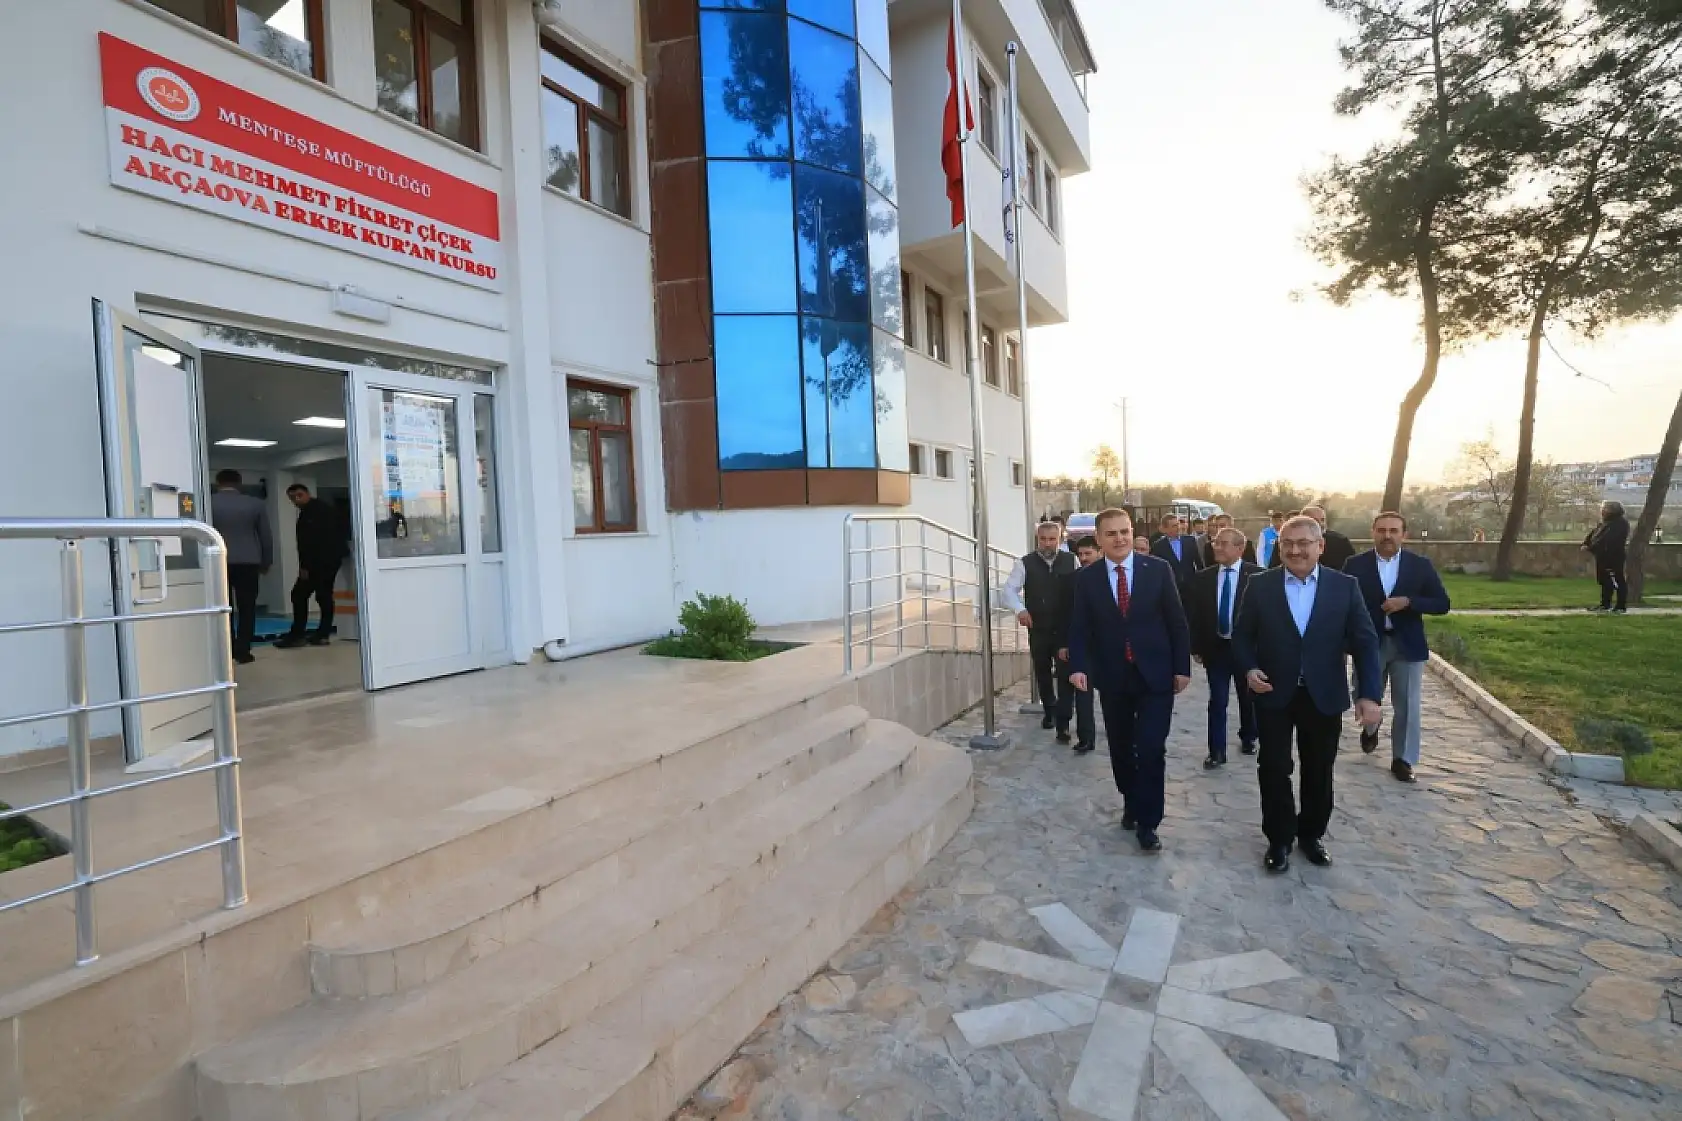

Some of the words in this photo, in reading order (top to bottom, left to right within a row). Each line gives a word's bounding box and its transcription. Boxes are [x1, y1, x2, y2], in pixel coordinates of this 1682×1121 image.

[121, 123, 205, 168] HACI
[210, 154, 331, 208] MEHMET
[335, 195, 414, 234] FİKRET
[417, 223, 474, 254] ÇİÇEK
[218, 106, 321, 157] MENTEŞE
[324, 147, 432, 198] MÜFTÜLÜĞÜ
[124, 154, 270, 214] AKÇAOVA
[273, 200, 359, 240] ERKEK
[361, 226, 436, 262] KUR'AN
[438, 251, 497, 280] KURSU
